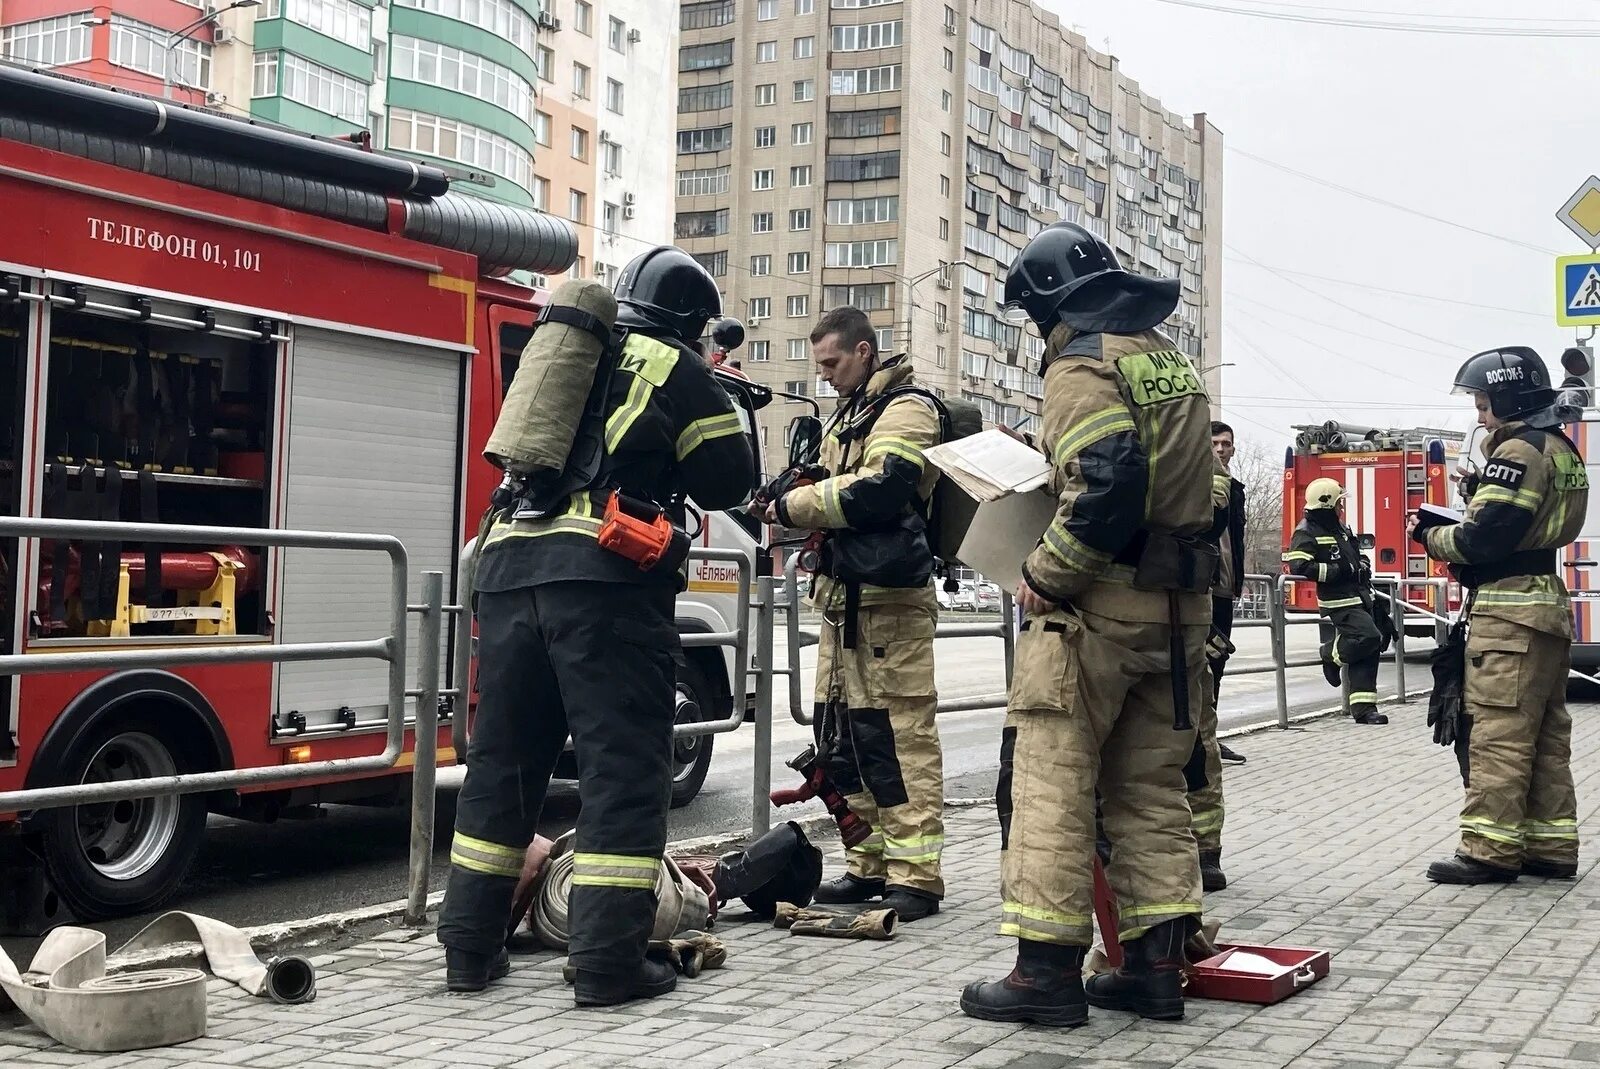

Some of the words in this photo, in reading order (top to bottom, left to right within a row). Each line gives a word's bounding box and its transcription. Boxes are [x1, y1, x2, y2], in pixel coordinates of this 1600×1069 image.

[88, 217, 197, 259] ТЕЛЕФОН
[202, 242, 228, 269] 01,
[234, 249, 261, 272] 101
[1074, 245, 1087, 259] 1
[620, 272, 628, 286] 1
[1146, 351, 1189, 371] МЧС
[1485, 367, 1524, 385] ВОСТОК-5
[1485, 464, 1522, 483] СПТ
[1384, 496, 1390, 510] 1
